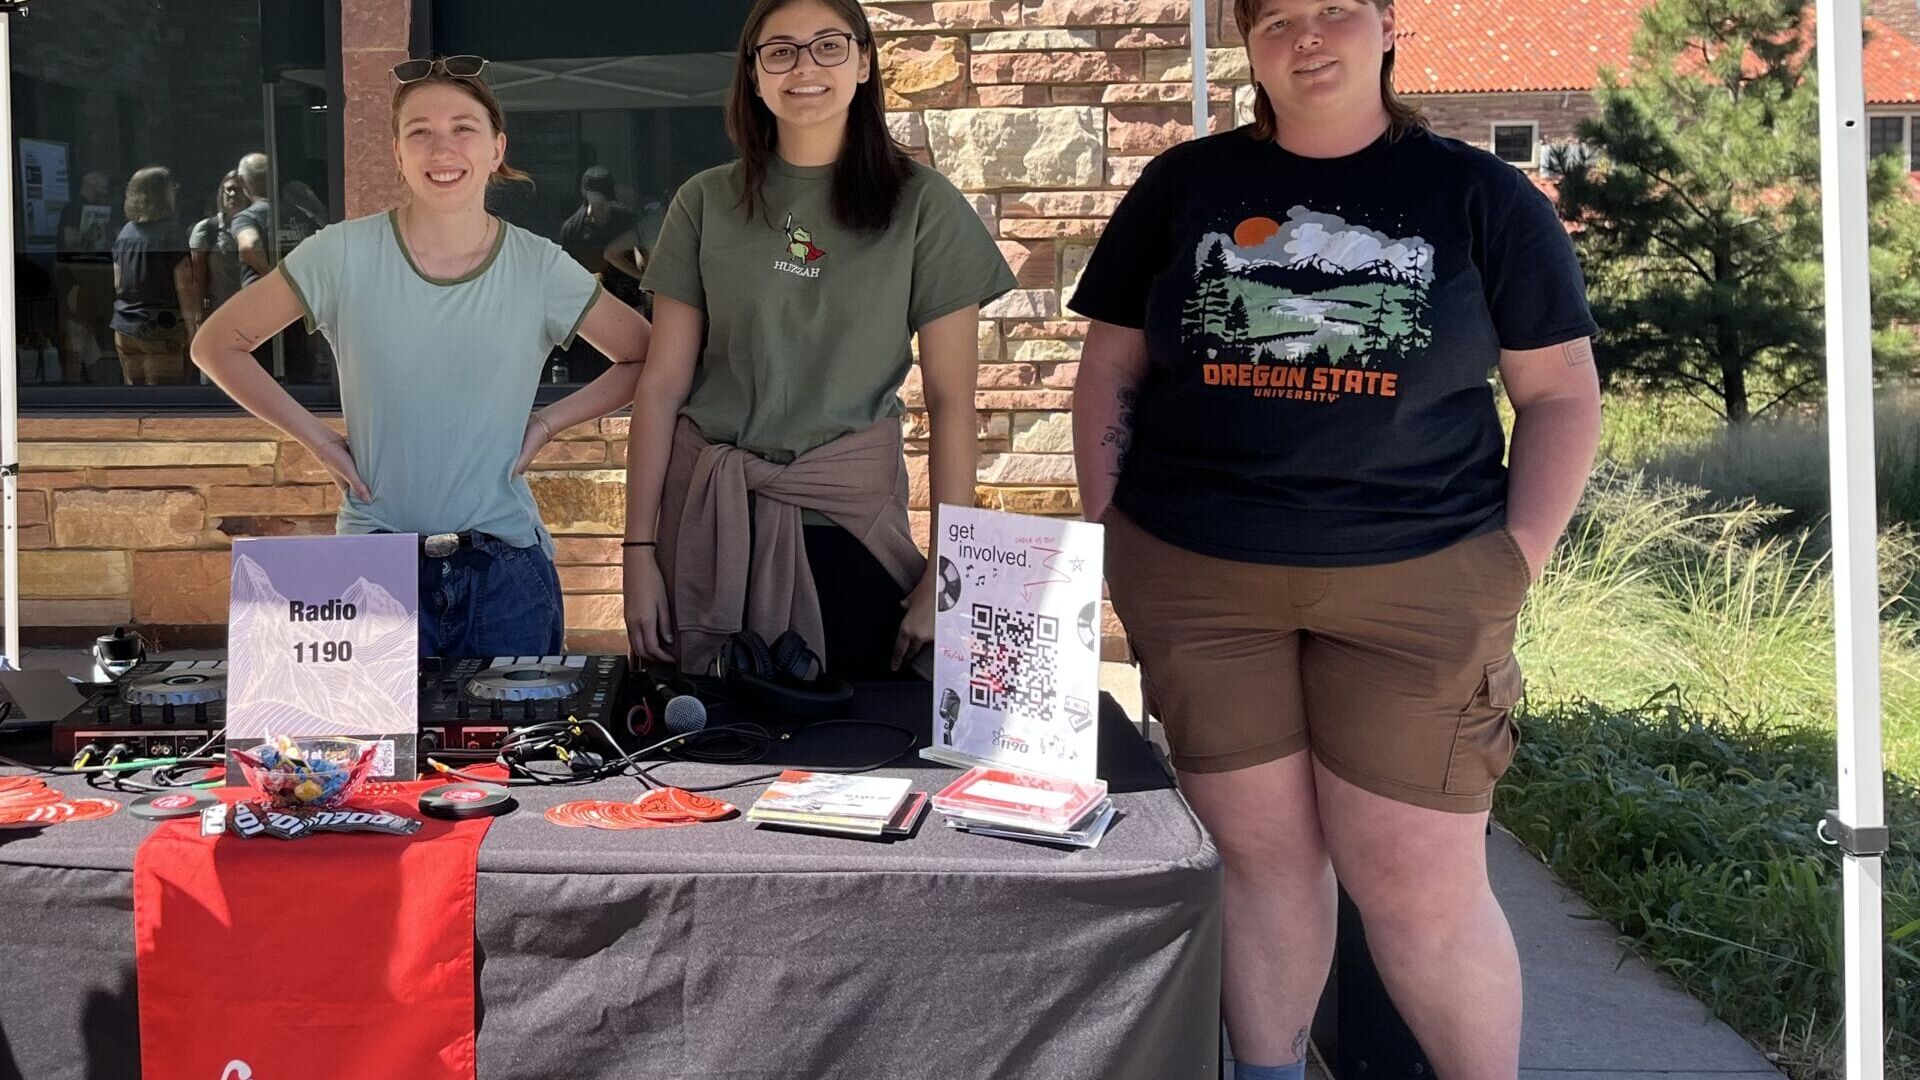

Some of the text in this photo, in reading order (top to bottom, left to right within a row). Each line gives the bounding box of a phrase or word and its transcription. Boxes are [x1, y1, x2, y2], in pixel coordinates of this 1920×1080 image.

[773, 261, 821, 278] HUZZAH
[1203, 363, 1399, 397] OREGON STATE
[1253, 387, 1337, 403] UNIVERSITY
[949, 523, 975, 542] get
[959, 540, 1032, 568] involved.
[289, 598, 357, 622] Radio
[293, 640, 353, 663] 1190
[1001, 739, 1029, 754] 1190
